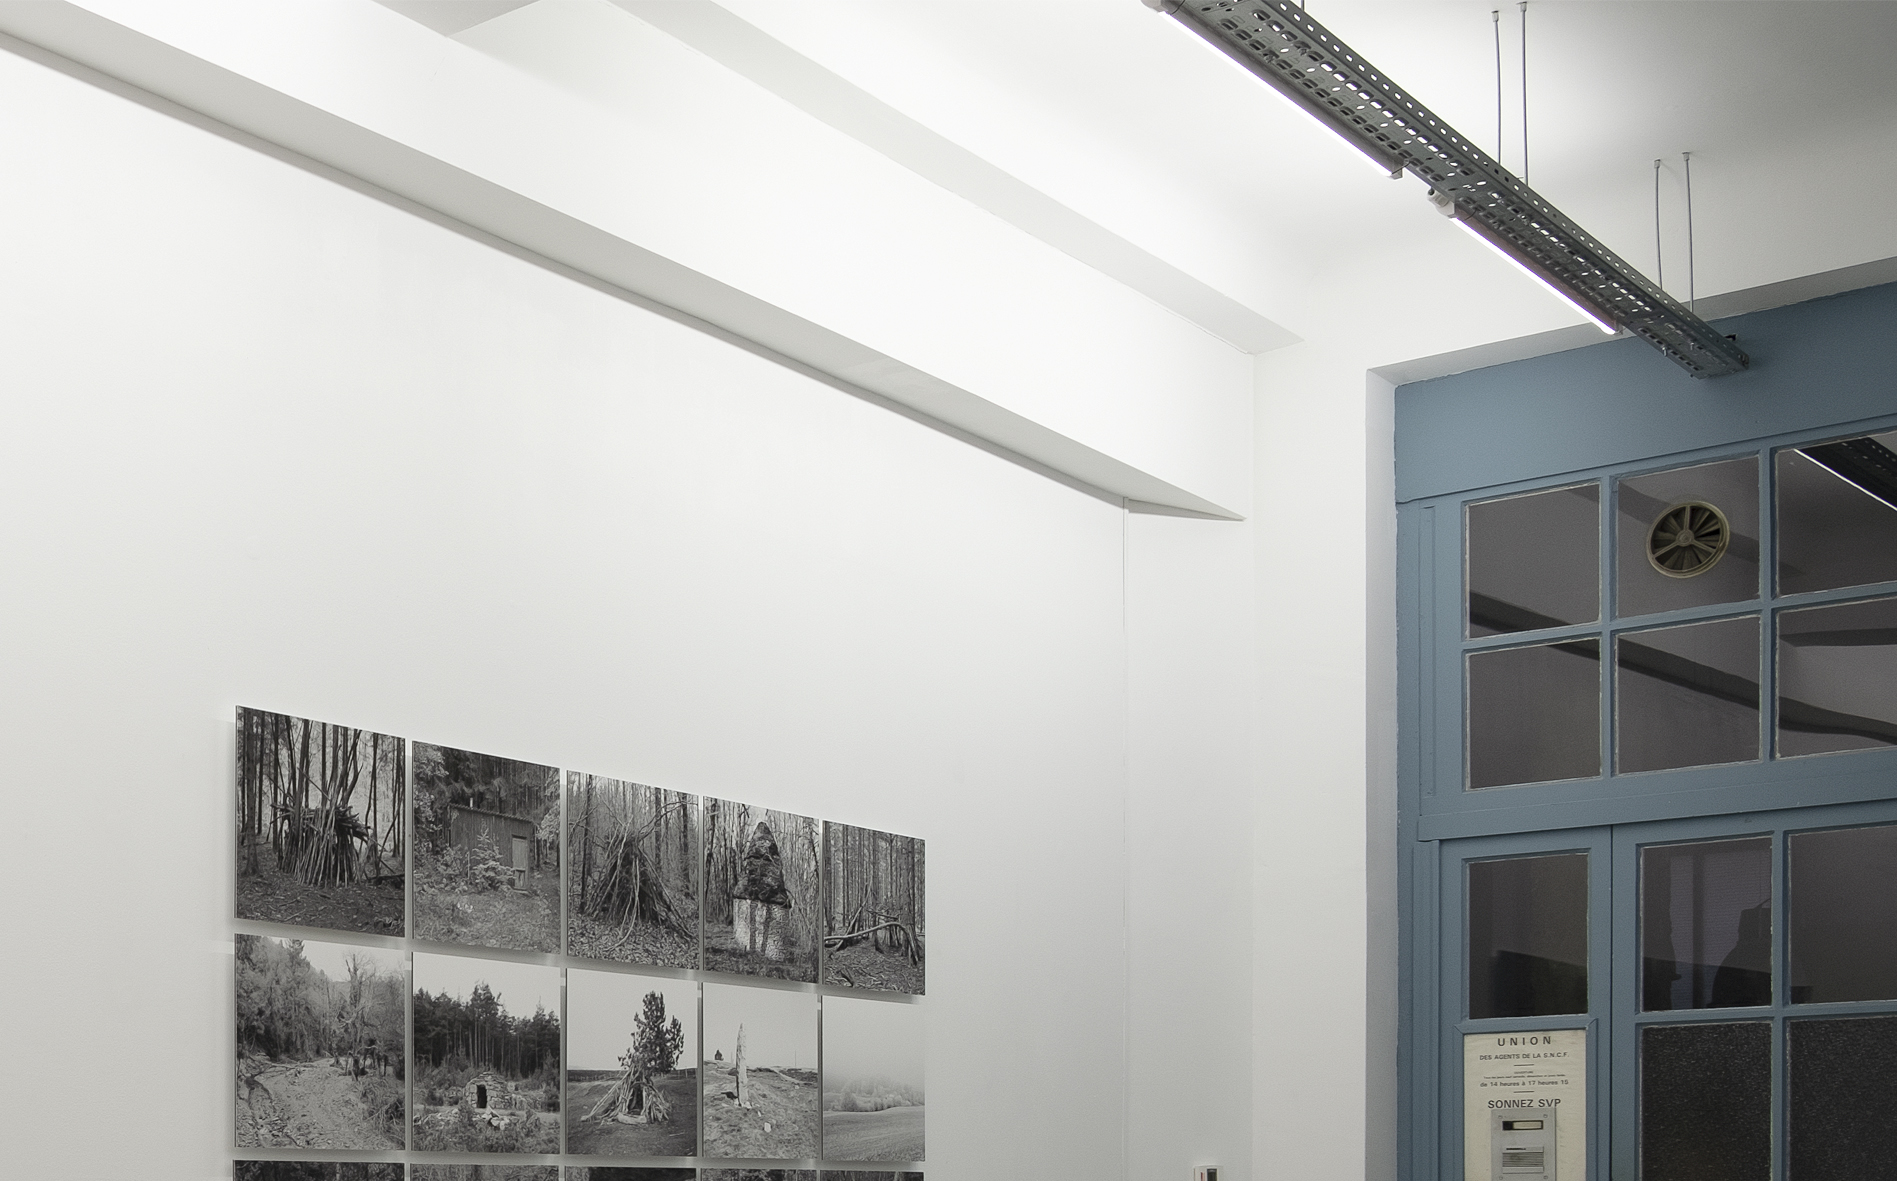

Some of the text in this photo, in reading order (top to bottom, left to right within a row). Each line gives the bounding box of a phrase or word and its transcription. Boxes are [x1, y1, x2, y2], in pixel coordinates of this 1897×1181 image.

[1497, 1036, 1552, 1047] UNION
[1487, 1098, 1562, 1109] SONNEZ SVP
